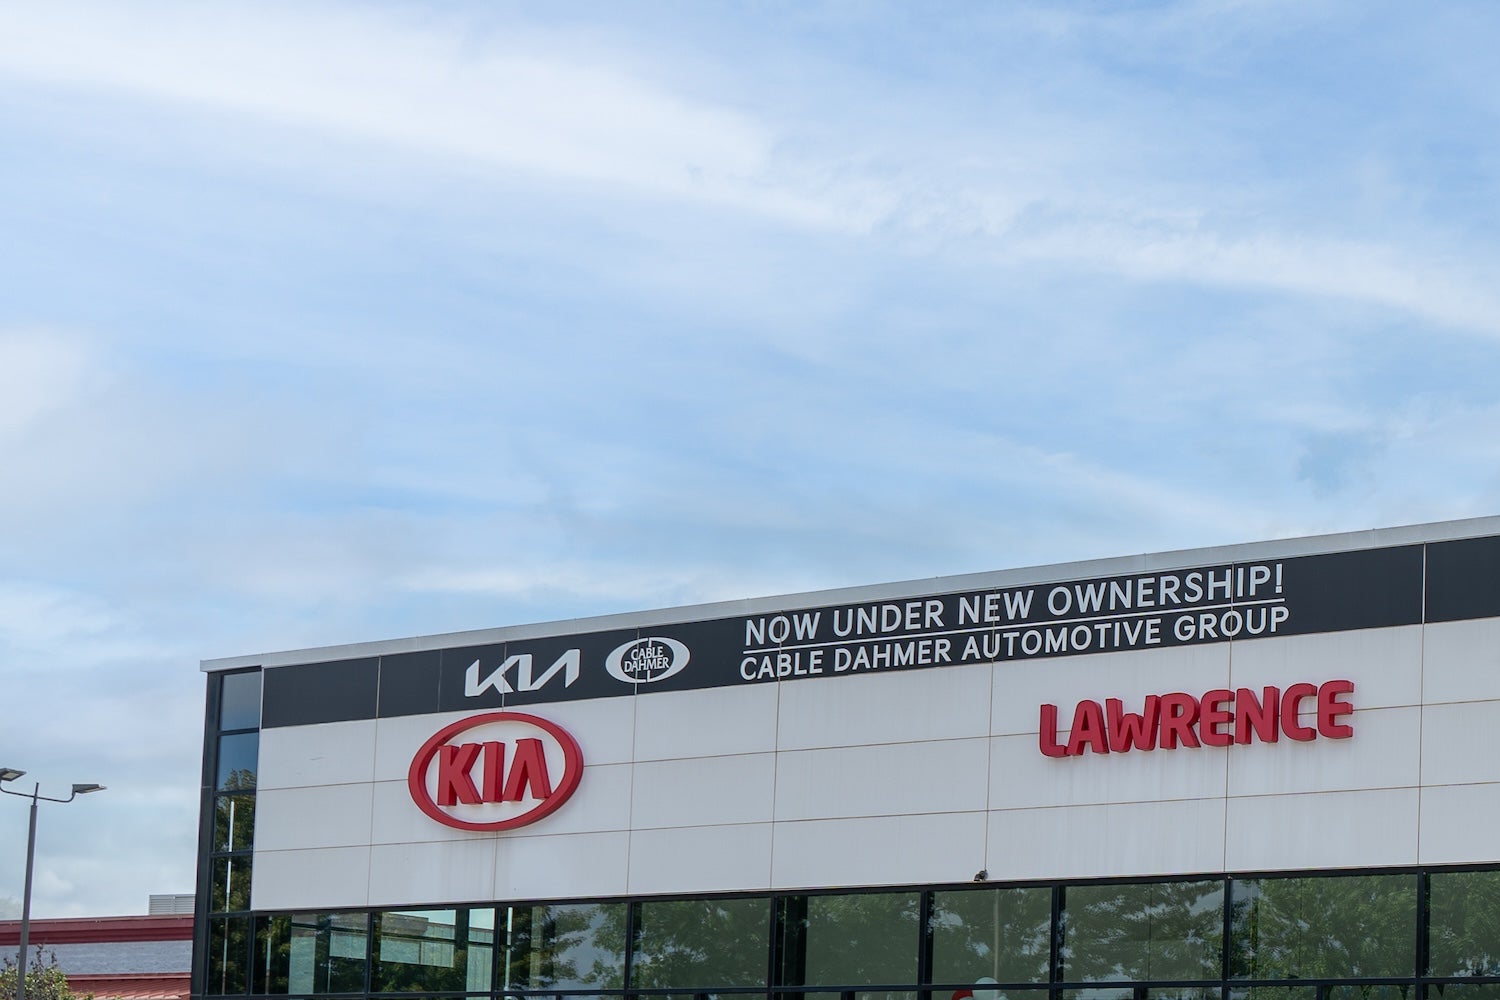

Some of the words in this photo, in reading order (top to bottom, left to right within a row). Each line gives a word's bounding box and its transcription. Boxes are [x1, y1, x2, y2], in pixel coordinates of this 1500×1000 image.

[745, 611, 821, 647] NOW
[833, 600, 945, 638] UNDER
[958, 589, 1034, 625] NEW
[1047, 563, 1283, 616] OWNERSHIP!
[464, 648, 581, 698] KIA
[624, 657, 670, 673] DAHMER
[630, 646, 664, 661] CABLE
[740, 650, 824, 681] CABLE
[834, 639, 952, 672] DAHMER
[961, 618, 1162, 661] AUTOMOTIVE
[1174, 606, 1290, 642] GROUP
[1039, 680, 1355, 758] LAWRENCE
[437, 738, 552, 806] KIA
